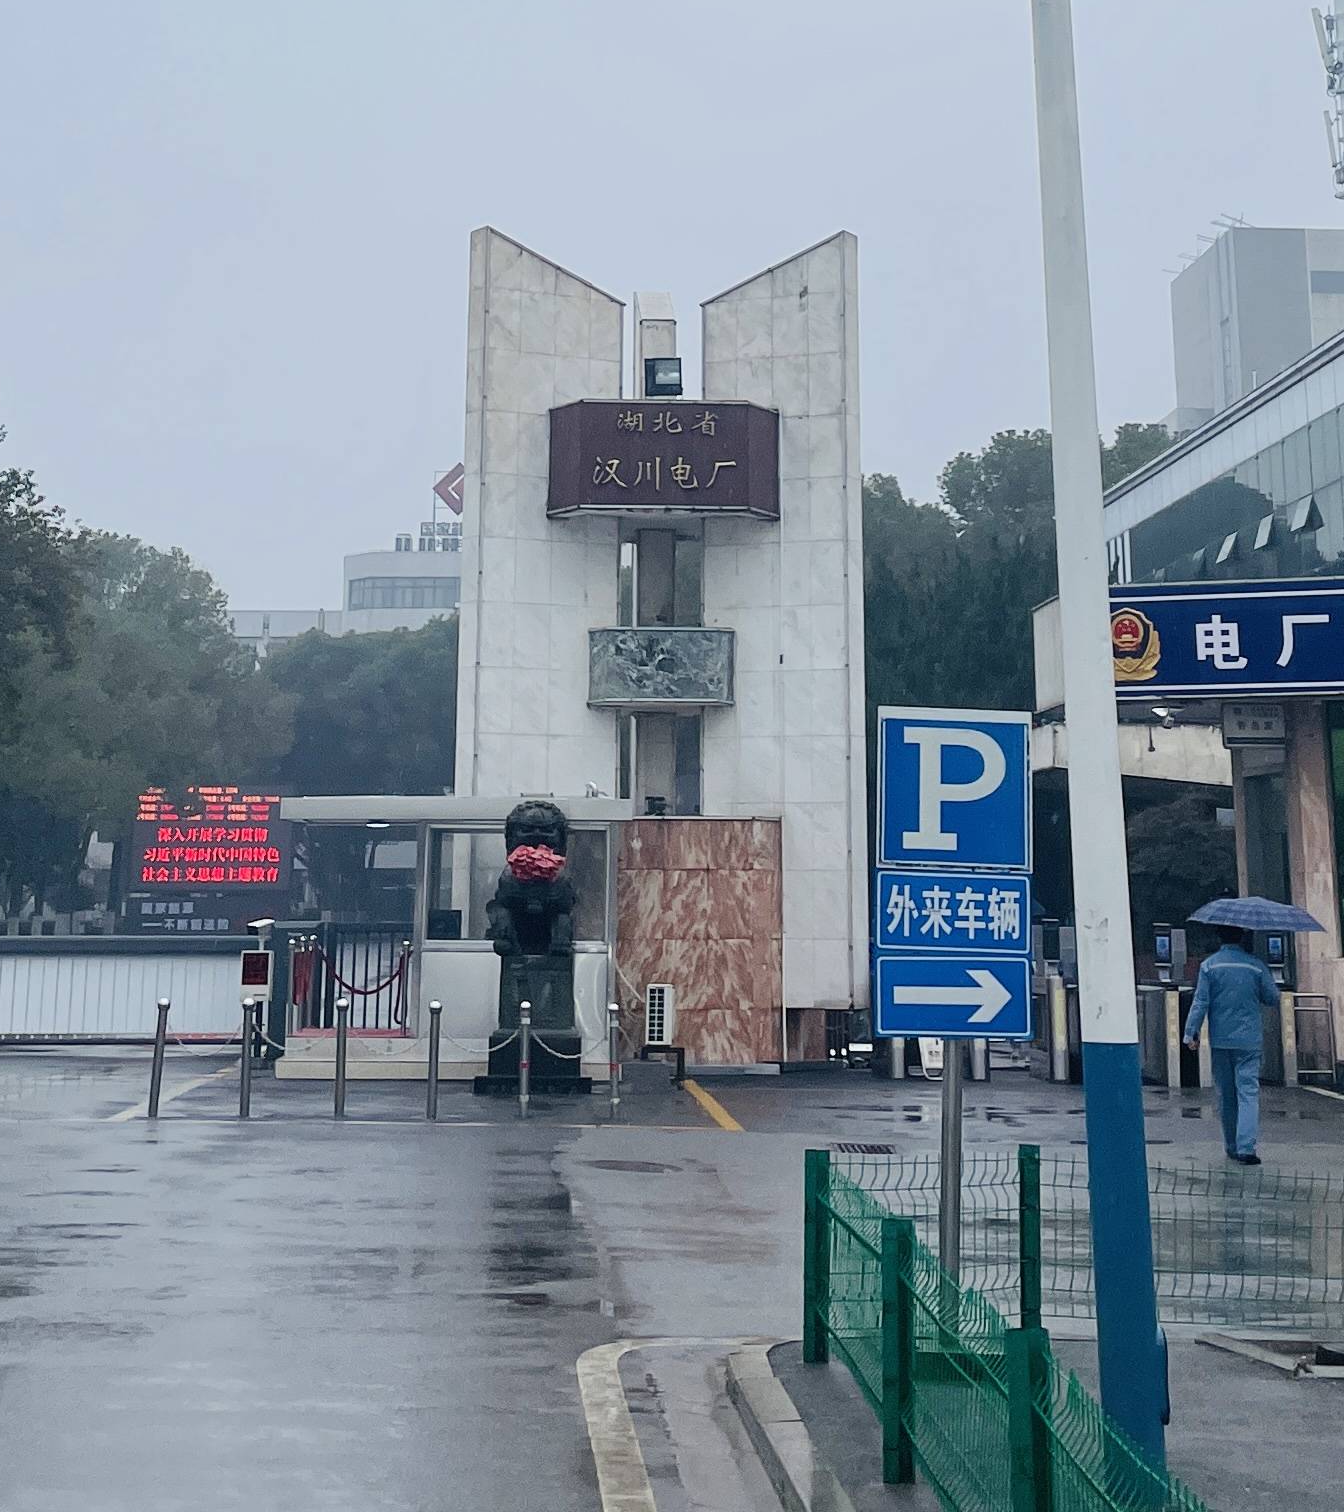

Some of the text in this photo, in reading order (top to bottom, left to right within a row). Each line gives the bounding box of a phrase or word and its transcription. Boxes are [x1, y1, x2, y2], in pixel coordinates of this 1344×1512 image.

[616, 409, 719, 437] 湖北省
[592, 456, 737, 491] 汉川电厂
[902, 725, 1007, 851] P
[143, 847, 280, 863] 习近平新时代中国特色
[142, 866, 279, 882] 社会主义思想主题教育
[886, 884, 1021, 941] 外来车辆
